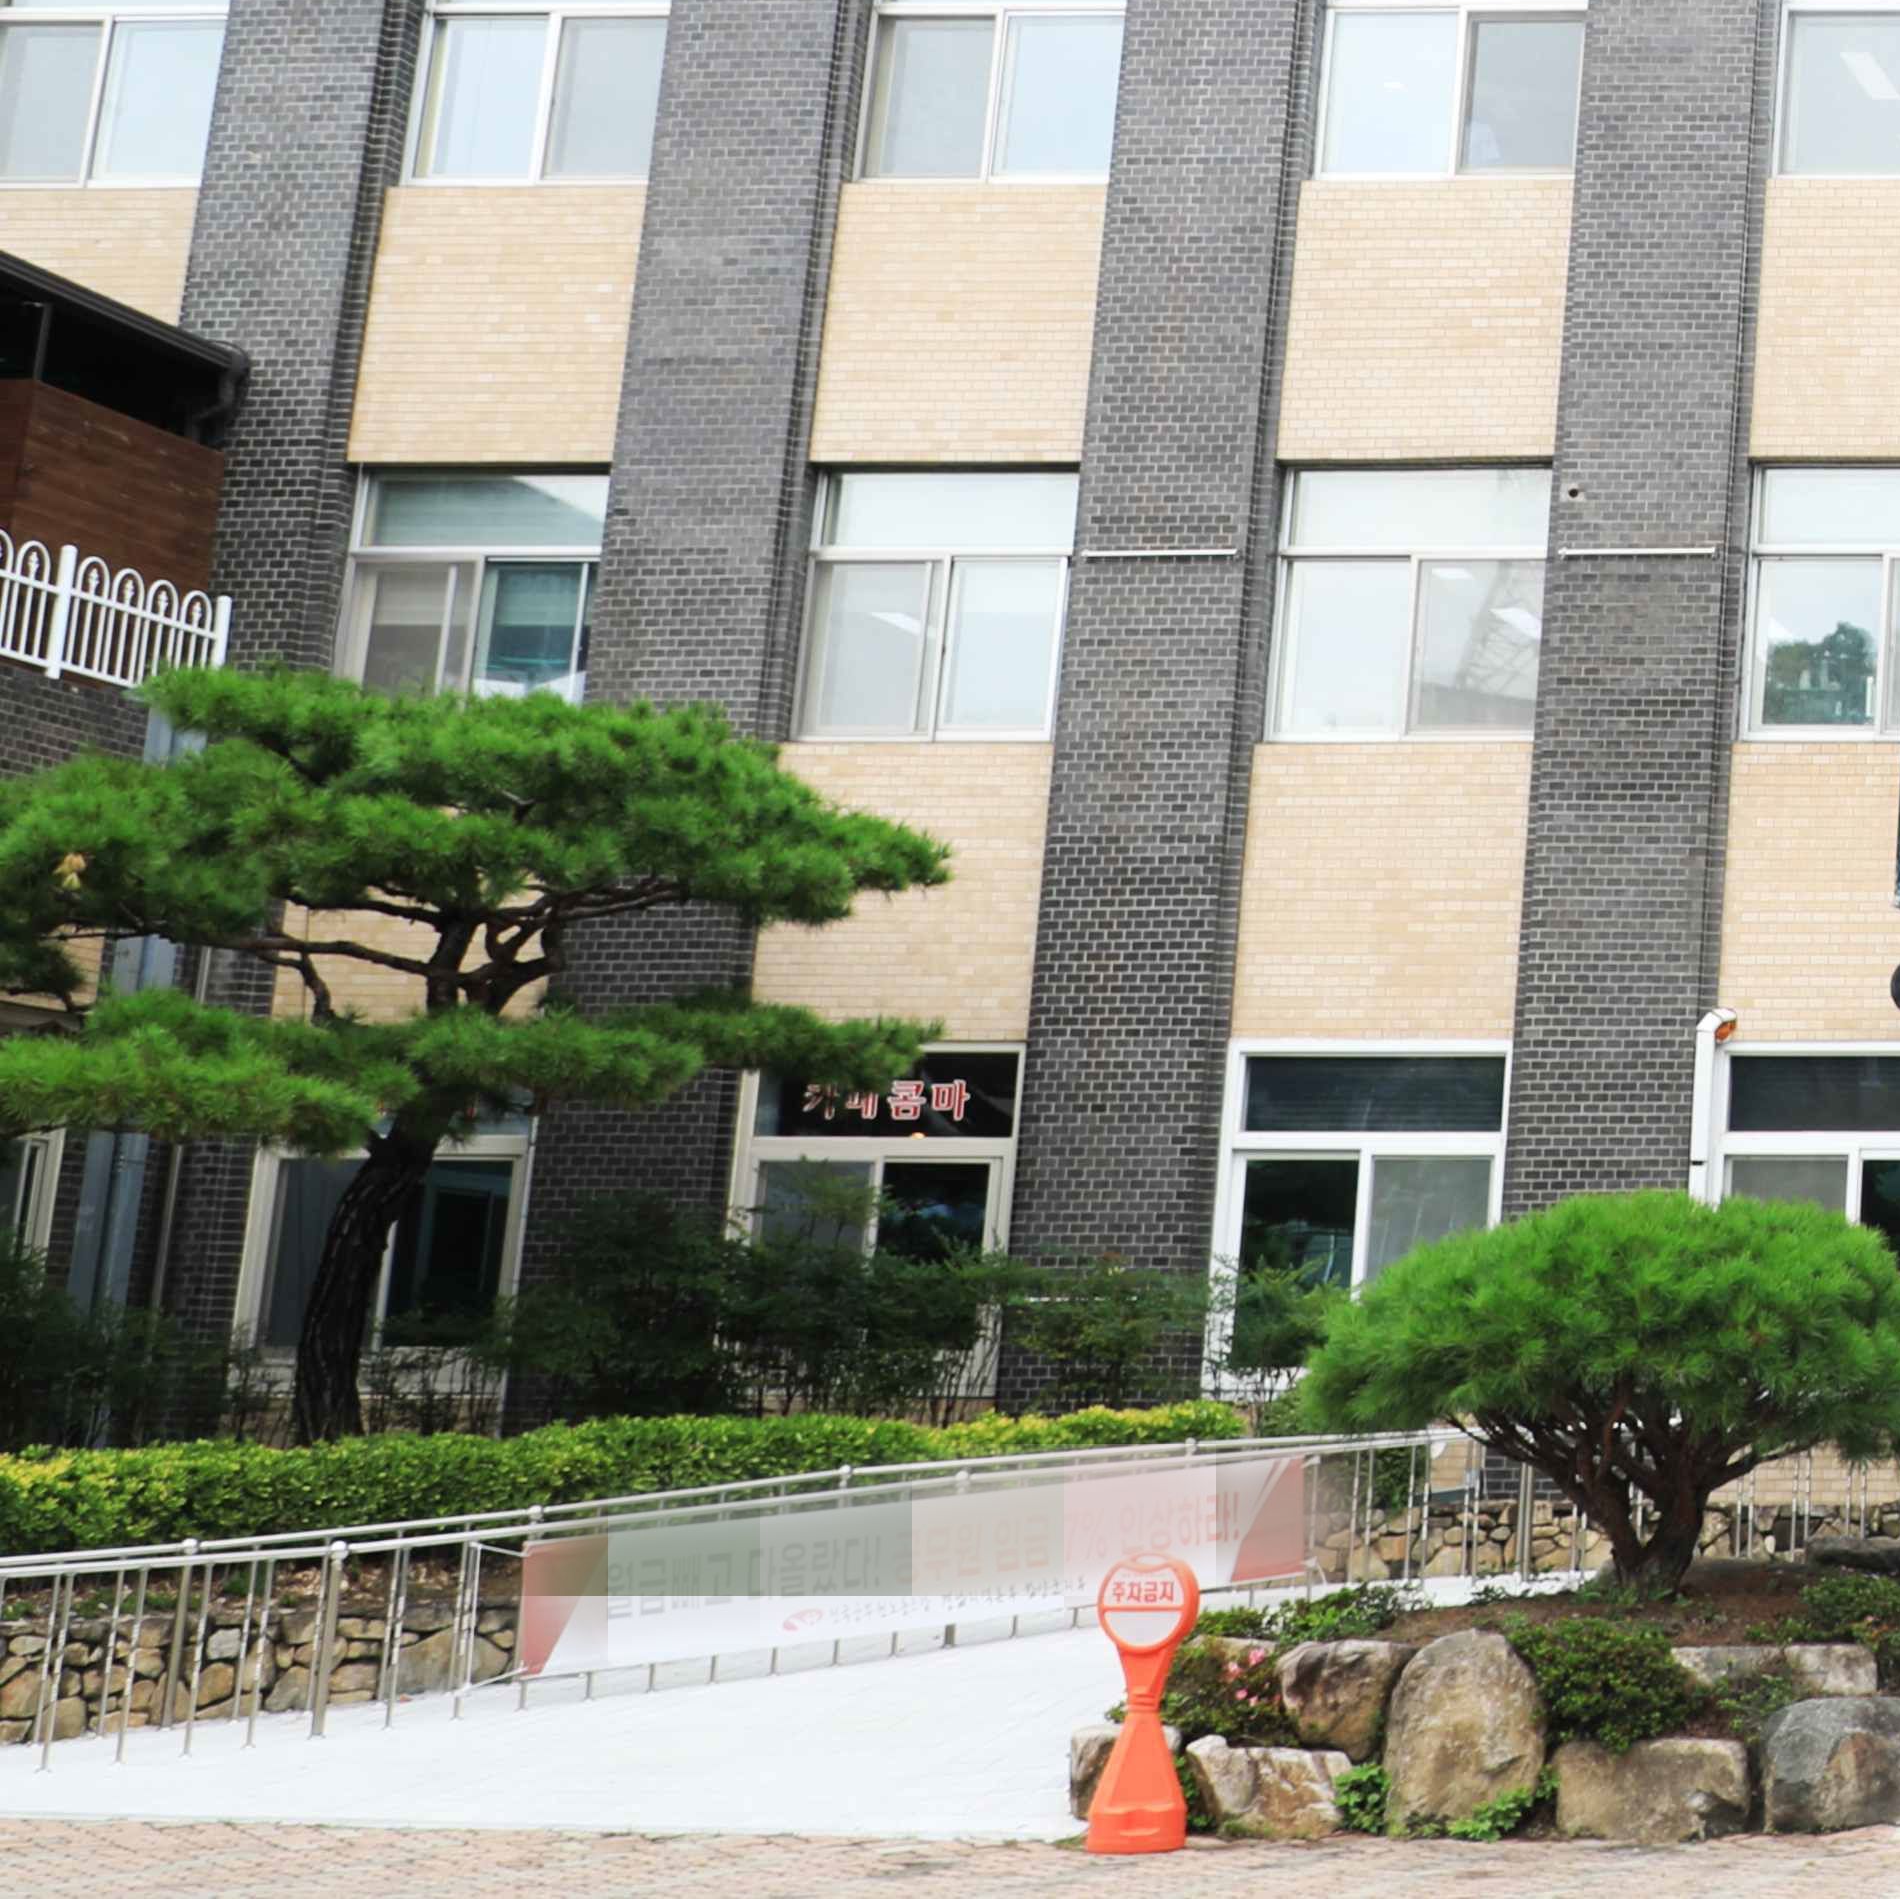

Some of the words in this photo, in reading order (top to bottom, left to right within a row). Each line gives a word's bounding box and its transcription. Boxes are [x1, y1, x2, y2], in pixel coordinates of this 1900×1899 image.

[994, 1511, 1050, 1574] 임금
[1066, 1508, 1107, 1562] 7%
[1112, 1580, 1175, 1605] 주차금지
